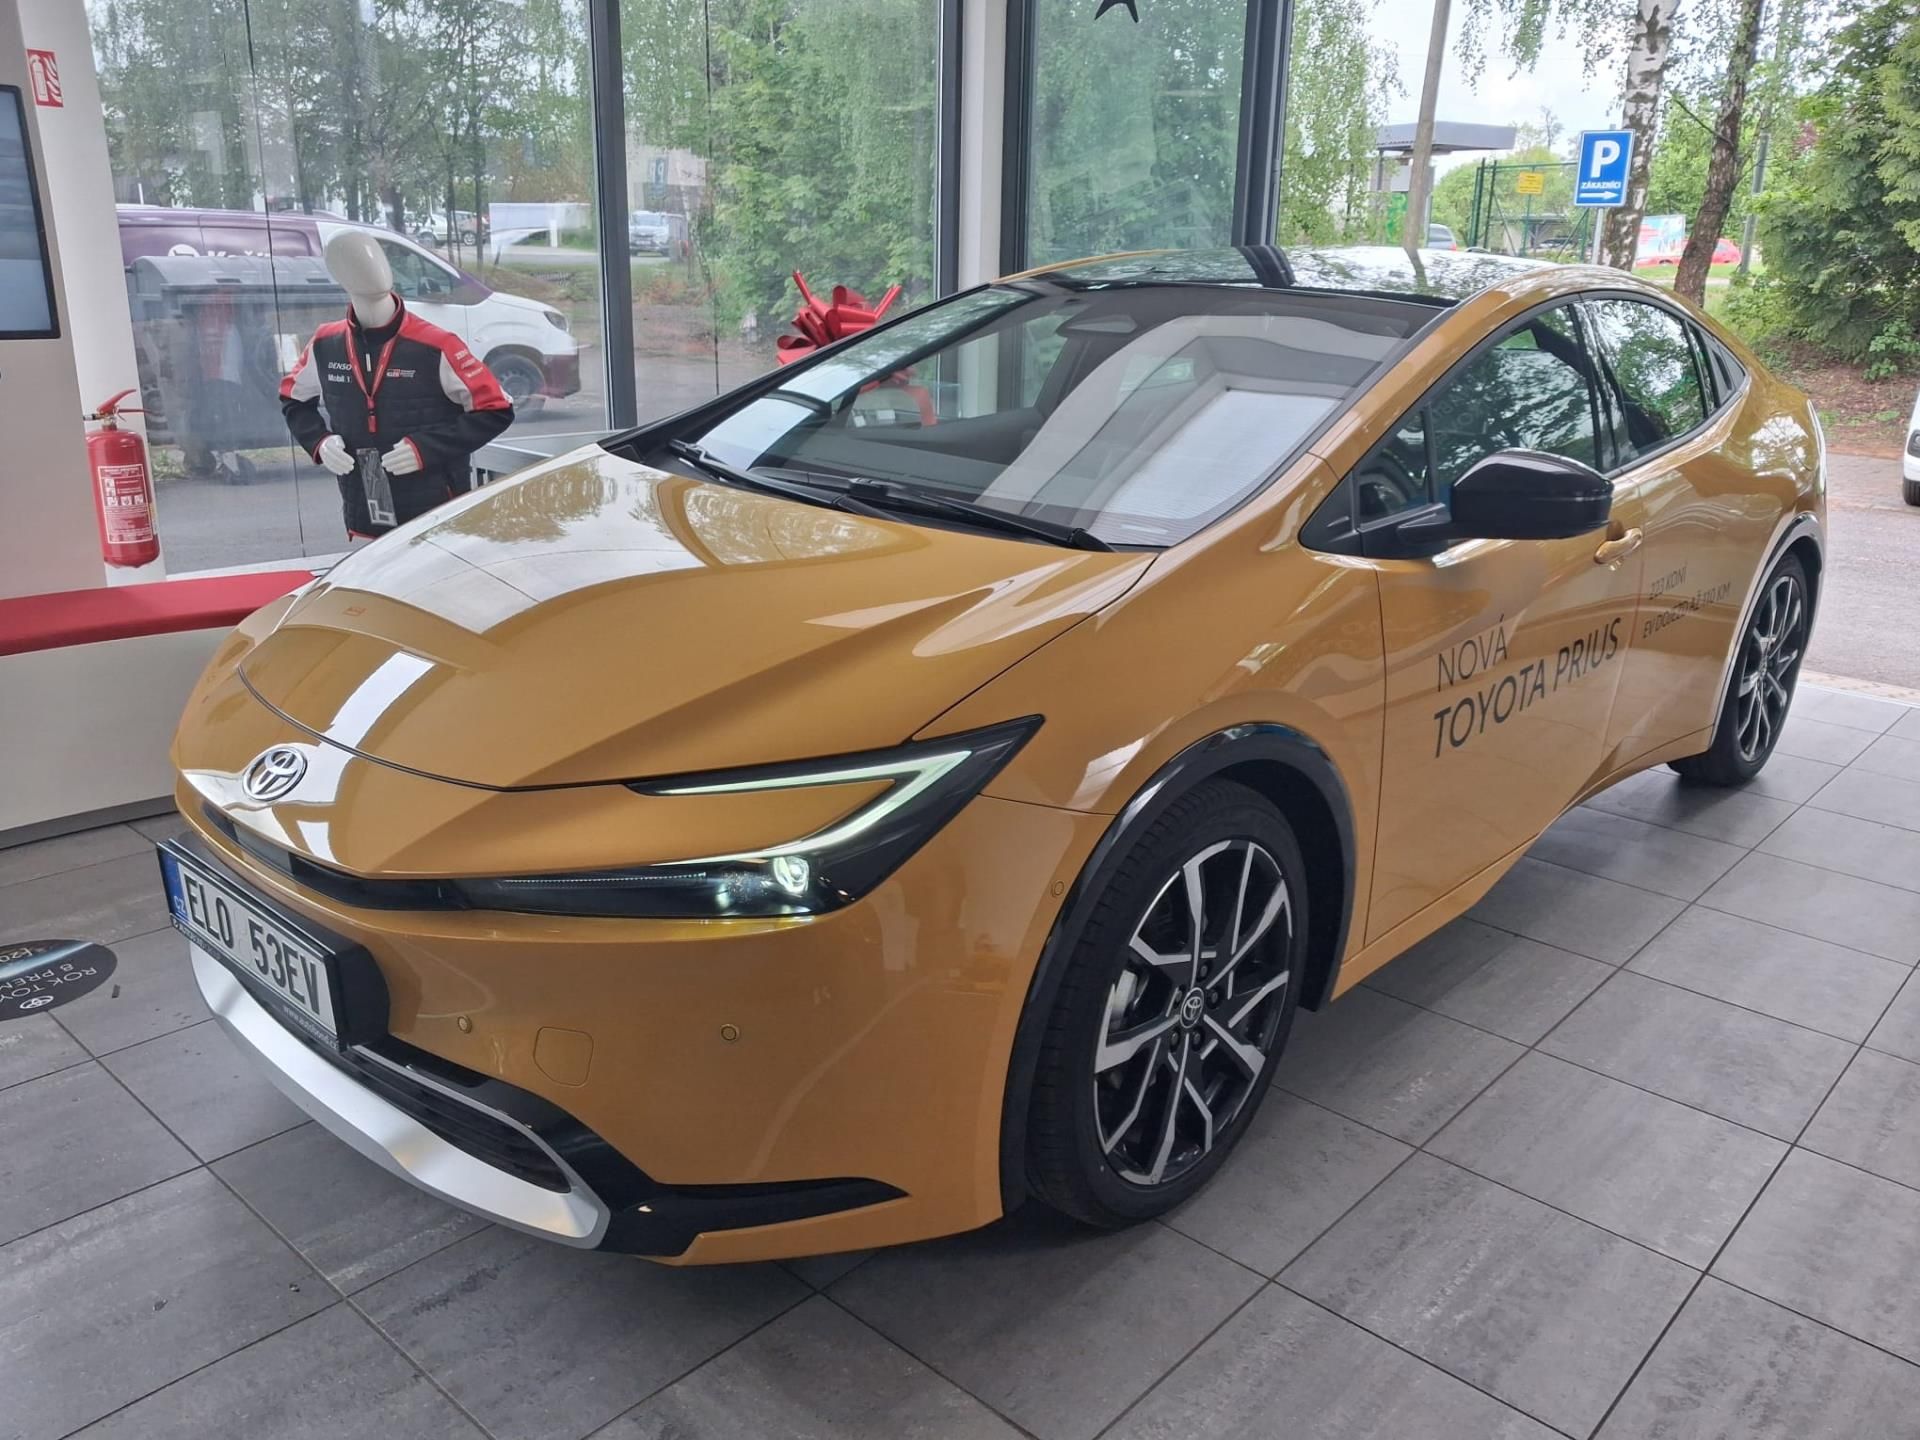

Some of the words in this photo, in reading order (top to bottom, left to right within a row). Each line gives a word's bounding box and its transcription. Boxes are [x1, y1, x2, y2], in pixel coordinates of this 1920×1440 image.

[1591, 140, 1620, 178] P
[328, 361, 352, 371] DENSO
[328, 374, 345, 382] Mobil
[1438, 614, 1508, 692] NOVÁ
[1434, 659, 1545, 758] TOYOTA
[1553, 617, 1621, 692] PRIUS
[173, 895, 187, 914] CZ
[47, 967, 97, 987] ROK
[247, 918, 321, 1016] 53EV
